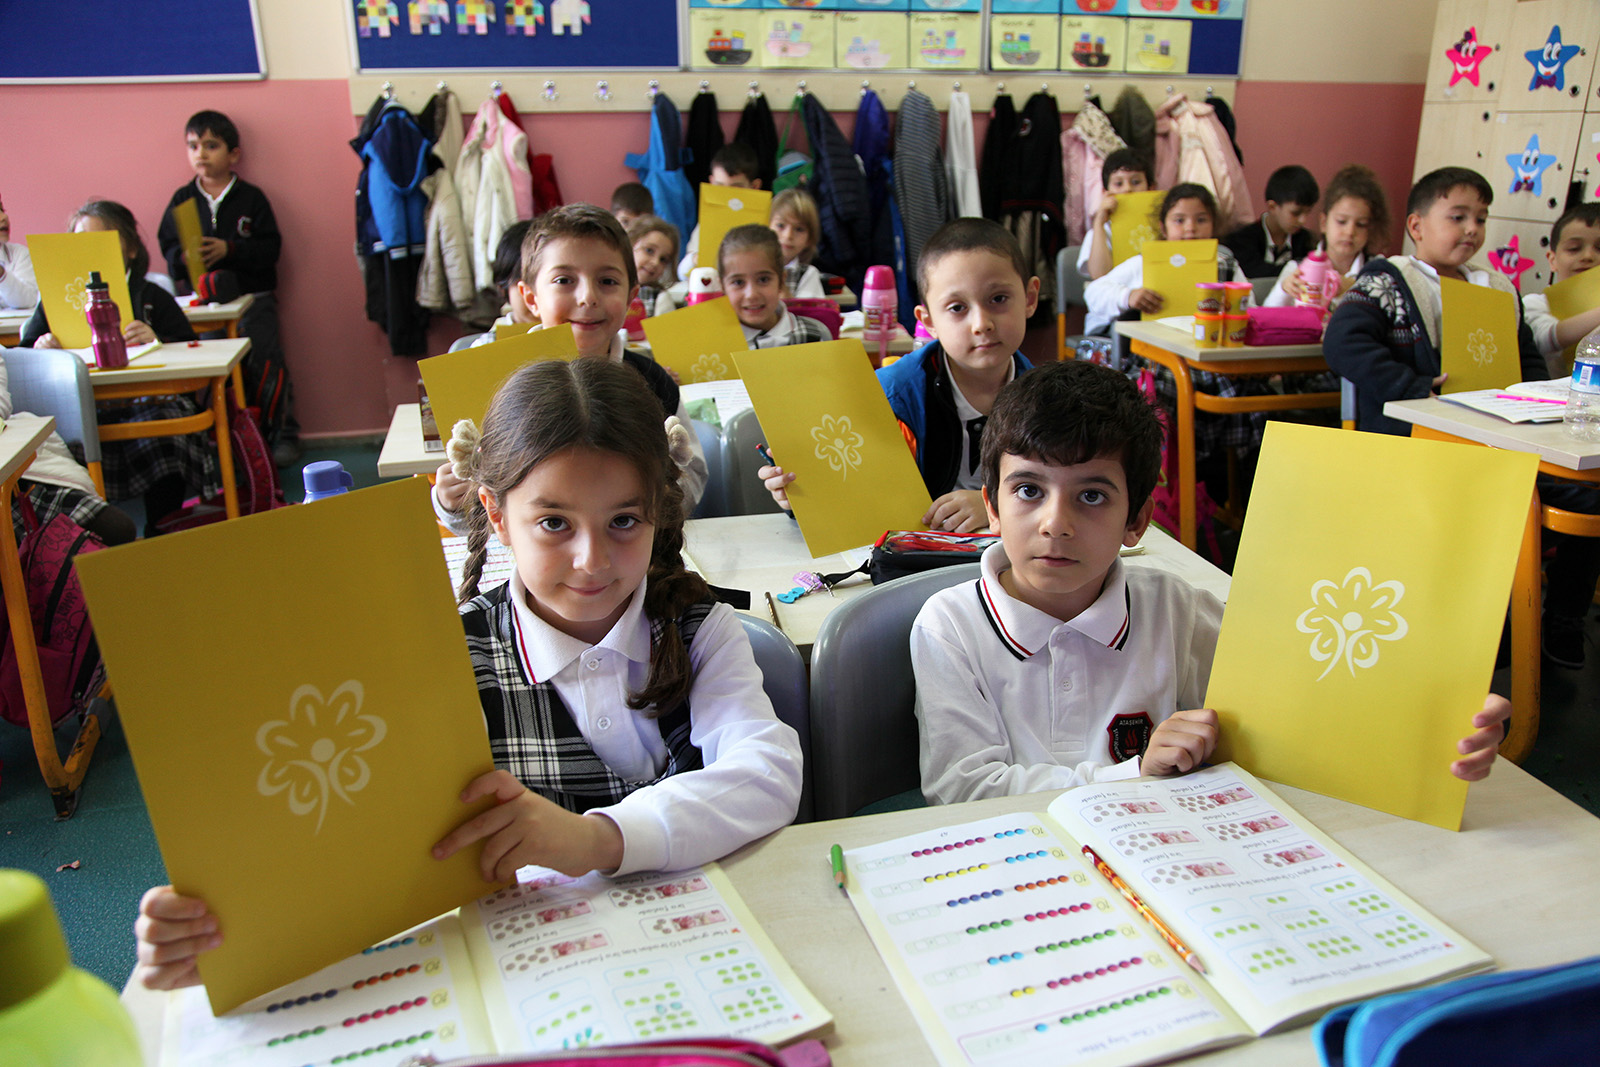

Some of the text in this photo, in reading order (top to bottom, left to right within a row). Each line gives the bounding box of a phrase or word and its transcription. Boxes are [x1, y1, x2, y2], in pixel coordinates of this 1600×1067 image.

[1031, 827, 1044, 836] 10
[1051, 848, 1064, 859] 10
[1072, 873, 1086, 884] 10
[1096, 900, 1110, 911] 10
[1121, 926, 1136, 937] 10
